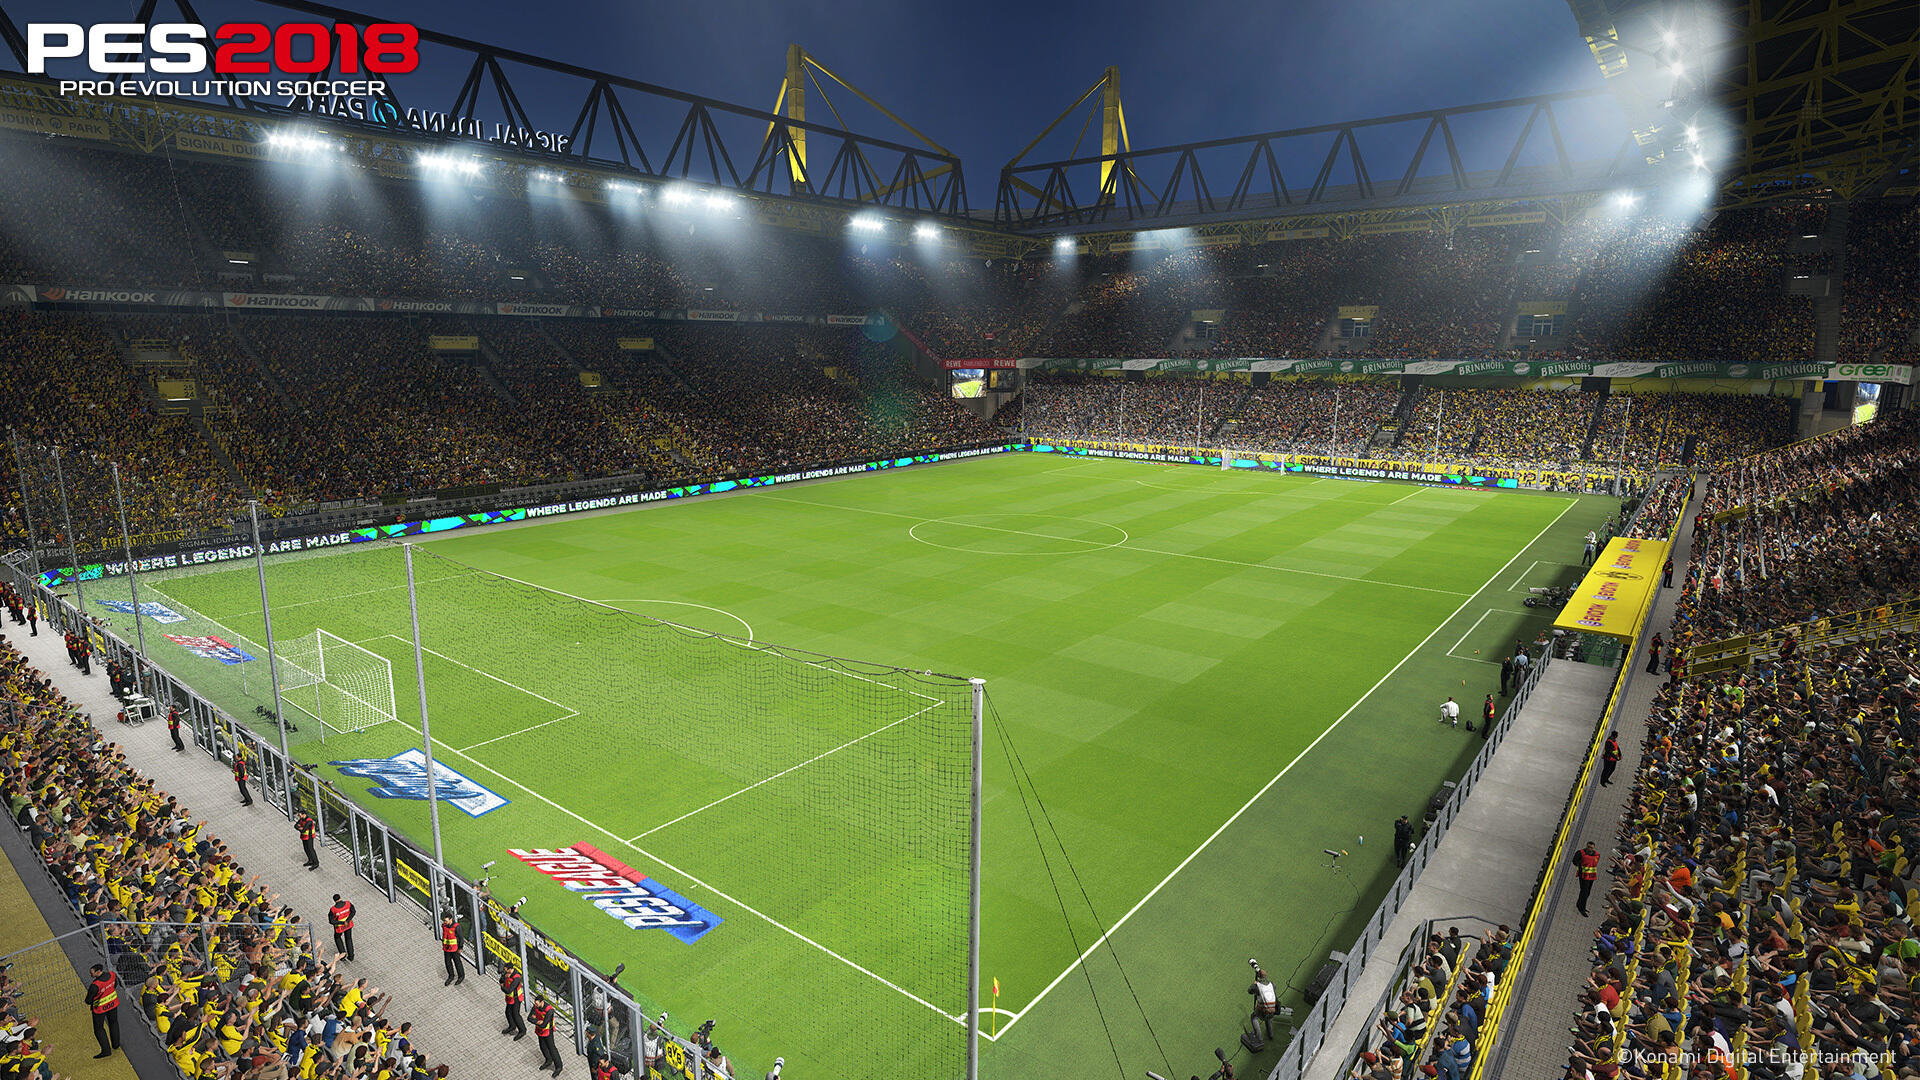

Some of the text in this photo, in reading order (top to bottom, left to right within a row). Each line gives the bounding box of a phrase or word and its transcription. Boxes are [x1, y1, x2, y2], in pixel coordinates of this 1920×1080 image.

[2, 113, 104, 135] IDUNA PARK
[180, 137, 226, 152] SIGNAL
[994, 359, 1015, 367] REWE
[1087, 449, 1191, 463] WHERE LEGENDS ARE MADE
[775, 463, 867, 483] WHERE LEGENDS ARE MADE
[1304, 464, 1338, 475] WHERE
[1340, 467, 1386, 479] LEGENDS
[1387, 470, 1408, 480] ARE
[1411, 472, 1442, 482] MADE
[527, 490, 667, 518] WHERE LEGENDS ARE MADE
[179, 538, 211, 549] SIGNAL
[213, 534, 239, 544] IDUNA
[105, 532, 351, 576] WHERE LEGENDS ARE MADE
